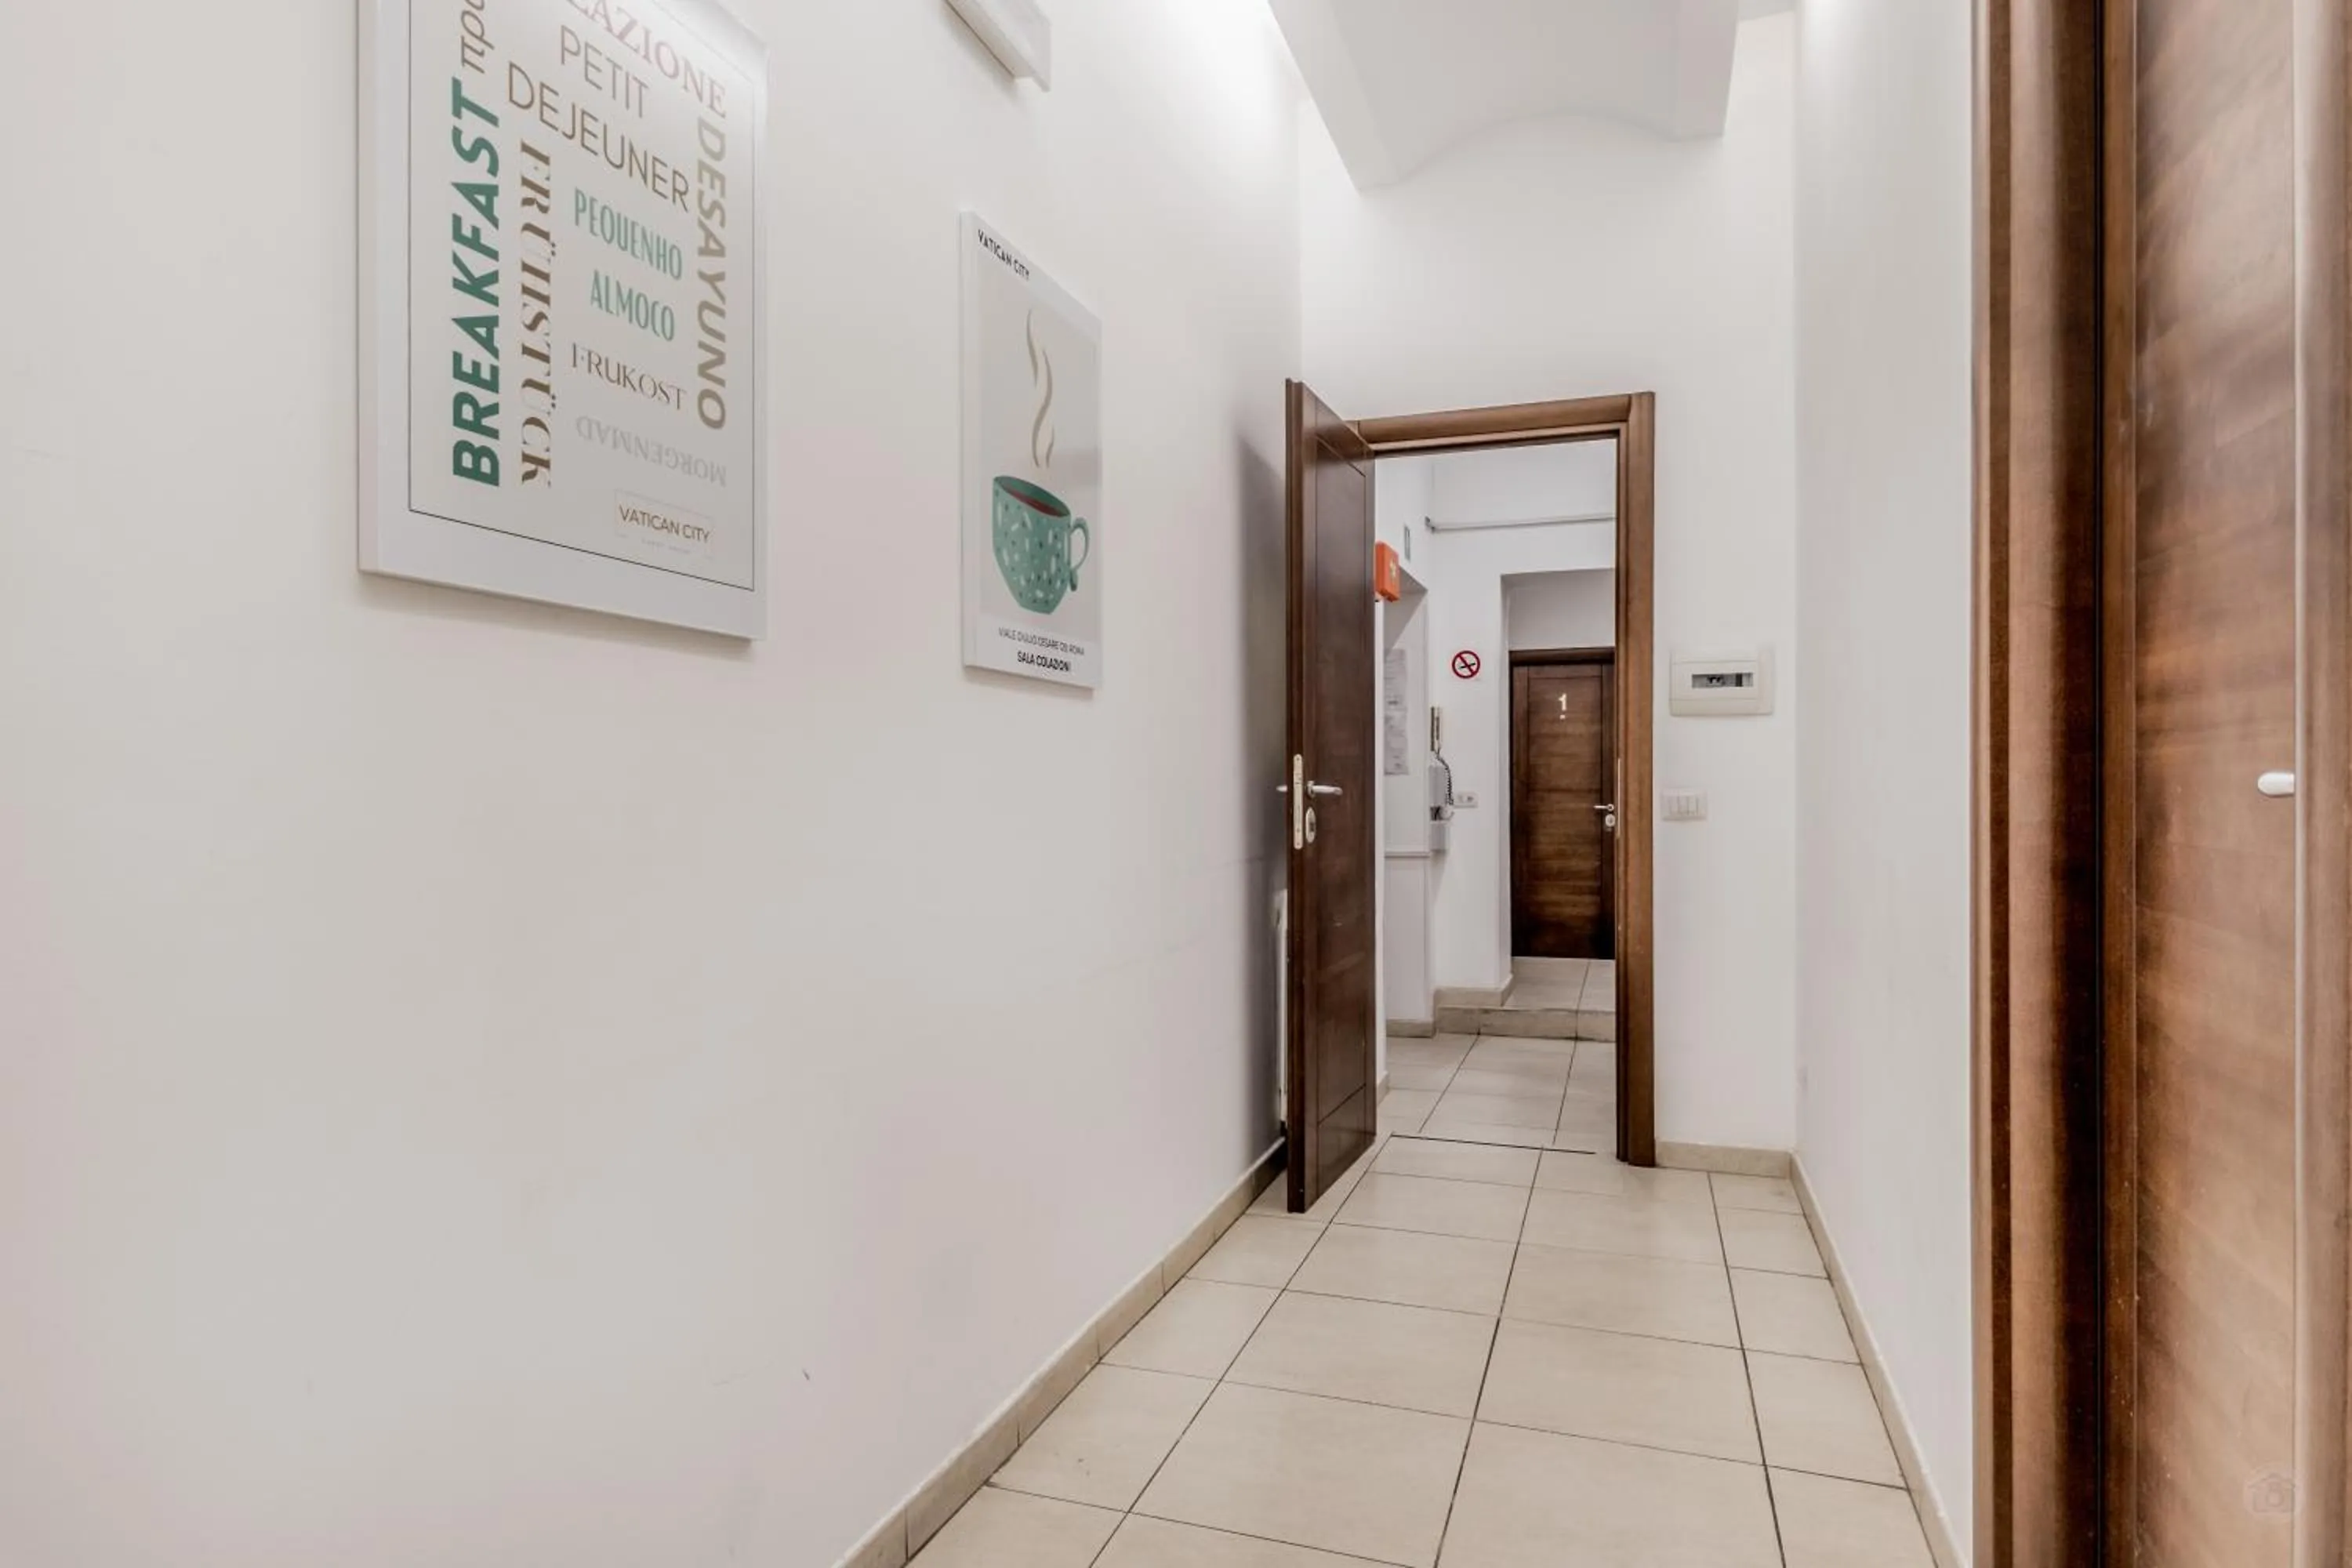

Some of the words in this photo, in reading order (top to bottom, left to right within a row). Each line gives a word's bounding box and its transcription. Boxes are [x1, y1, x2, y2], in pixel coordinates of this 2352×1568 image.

[461, 0, 495, 74] πρ
[560, 24, 649, 118] PETIT
[509, 61, 689, 212] DEJEUNER
[575, 187, 682, 281] PEQUENHO
[978, 228, 1012, 267] VATICAN
[1013, 258, 1029, 282] CITY
[451, 76, 499, 487] BREAKFAST
[590, 269, 674, 342] ALMOCO
[697, 116, 726, 430] DESAYUNO
[521, 139, 556, 488] FRÜHSTÜCK
[572, 342, 687, 411] FRUKOST
[576, 416, 726, 487] MORGENMAD
[619, 503, 681, 536] VATICAN
[682, 524, 710, 544] CITY
[1017, 650, 1035, 665] SALA
[1558, 692, 1567, 712] 1
